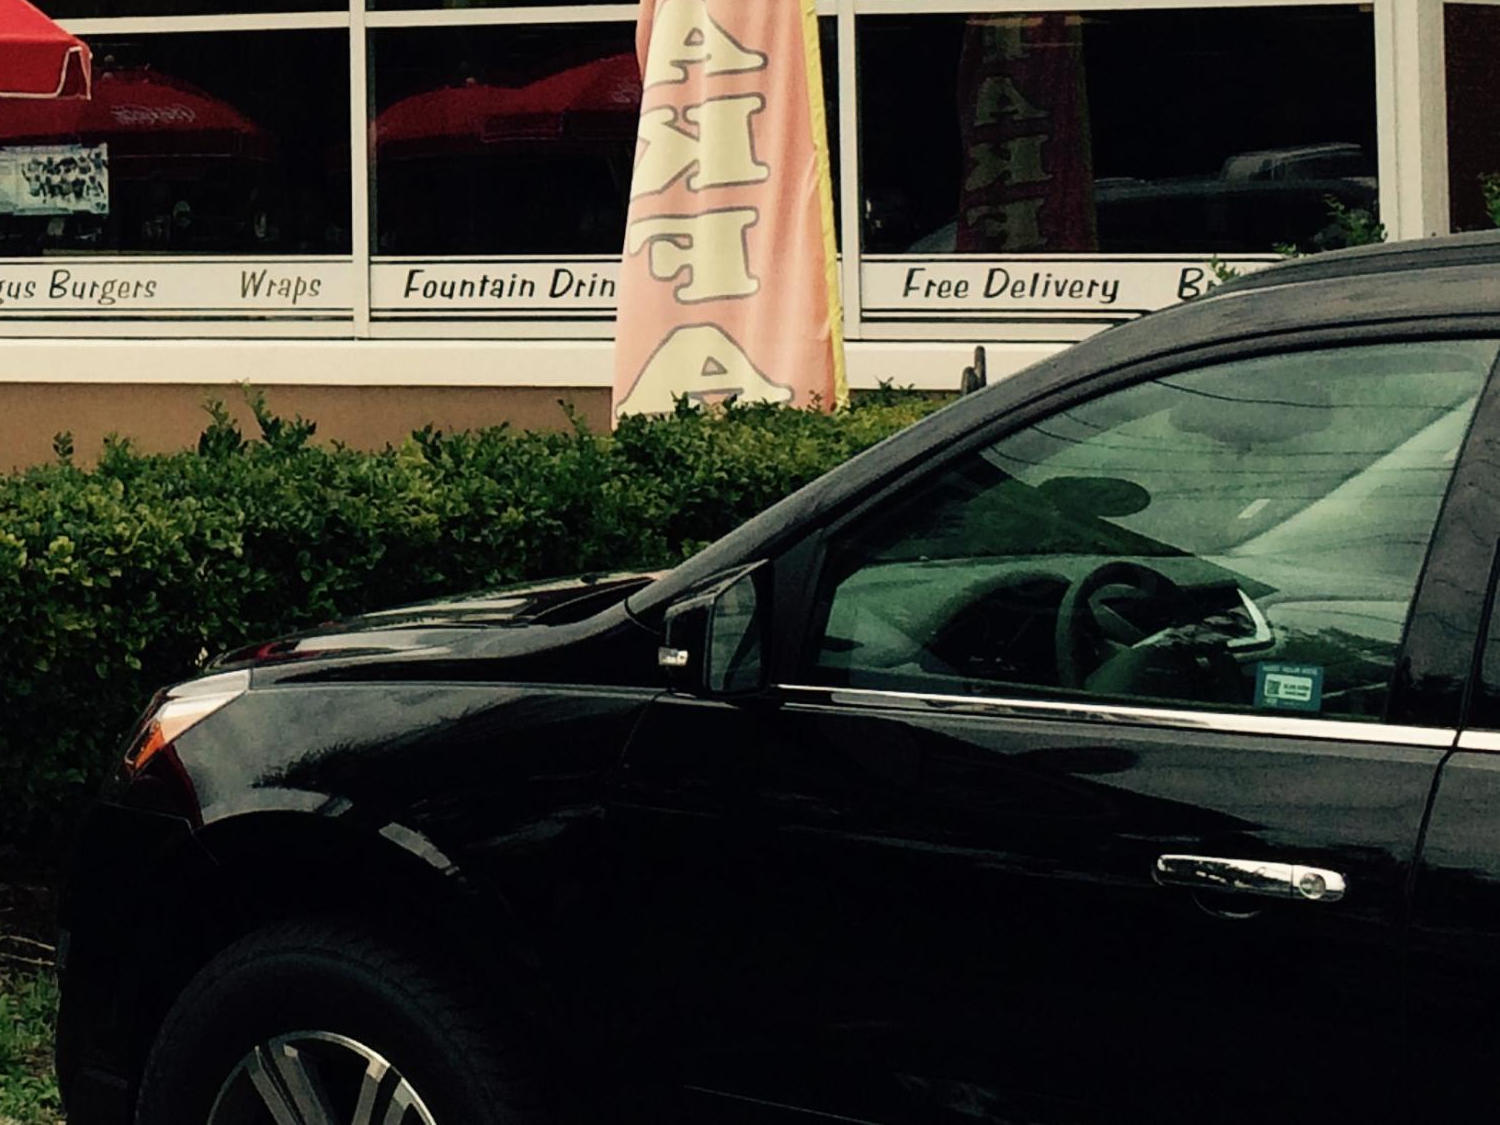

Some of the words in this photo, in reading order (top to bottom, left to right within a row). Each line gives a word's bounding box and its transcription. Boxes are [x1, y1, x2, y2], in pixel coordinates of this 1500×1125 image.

[48, 269, 157, 305] Burgers
[240, 270, 321, 304] Wraps
[404, 269, 535, 299] Fountain
[549, 269, 616, 298] Drin
[903, 268, 969, 299] Free
[983, 268, 1120, 303] Delivery
